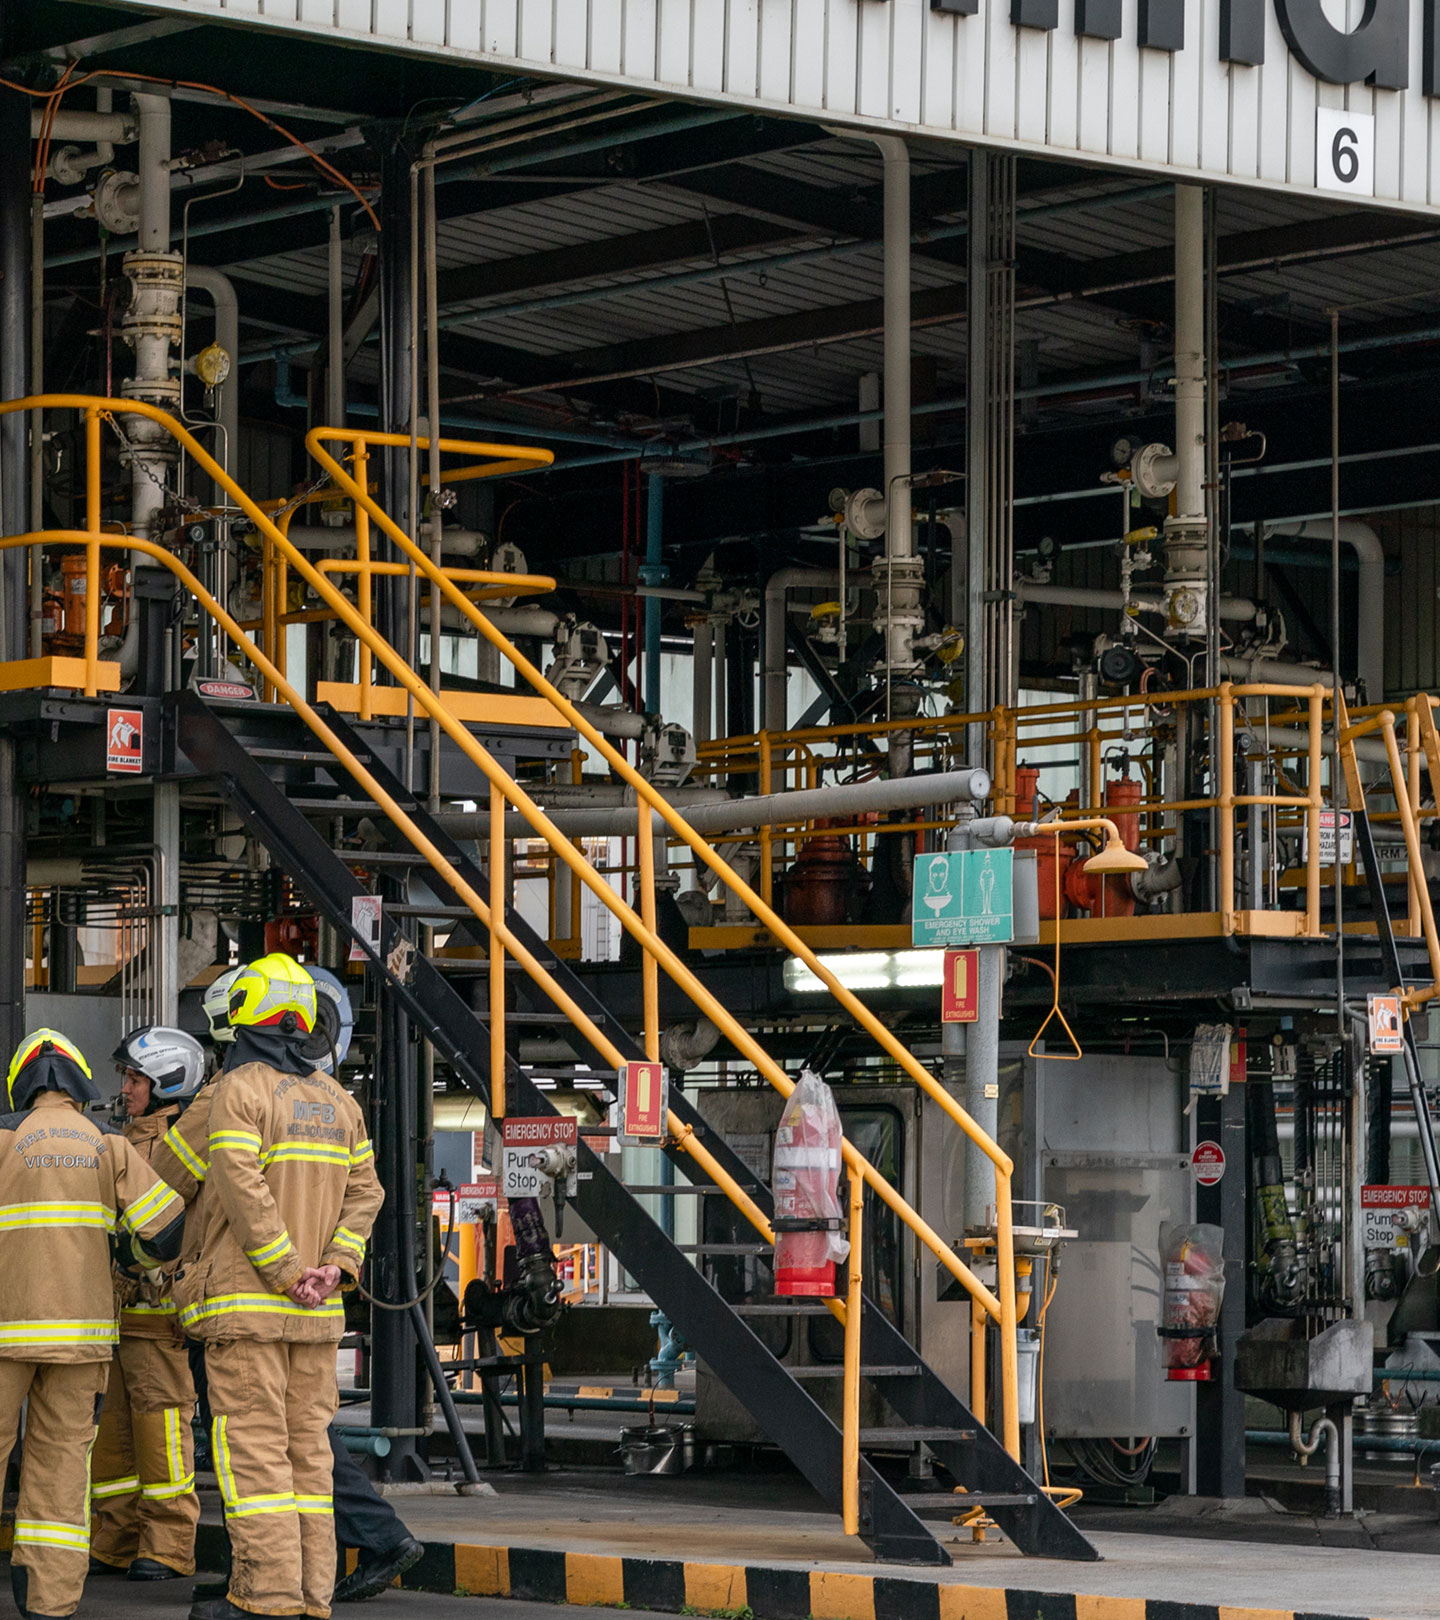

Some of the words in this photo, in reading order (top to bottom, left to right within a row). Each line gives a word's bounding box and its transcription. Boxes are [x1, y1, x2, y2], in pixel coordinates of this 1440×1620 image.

[1331, 127, 1360, 184] 6
[206, 683, 247, 696] DANGER
[925, 920, 967, 929] EMERGENCY
[969, 917, 1001, 926] SHOWER
[936, 928, 951, 937] AND
[952, 928, 968, 936] EYE
[969, 926, 990, 935] WASH
[946, 1011, 975, 1019] EXTINGUISHER
[293, 1099, 336, 1124] MFB
[638, 1113, 648, 1122] FIRE
[287, 1122, 346, 1142] MELBOURNE
[505, 1122, 552, 1140] EMERGENCY
[554, 1122, 574, 1139] STOP
[628, 1123, 657, 1133] EXTINGUISHER
[15, 1128, 48, 1155] FIRE
[49, 1127, 108, 1156] RESCUE
[24, 1154, 99, 1169] VICTORIA
[507, 1172, 537, 1191] Stop
[460, 1186, 484, 1195] EMERGENCY
[485, 1185, 497, 1195] STOP
[1363, 1190, 1407, 1203] EMERGENCY
[1408, 1190, 1428, 1203] STOP
[1366, 1228, 1394, 1244] Stop
